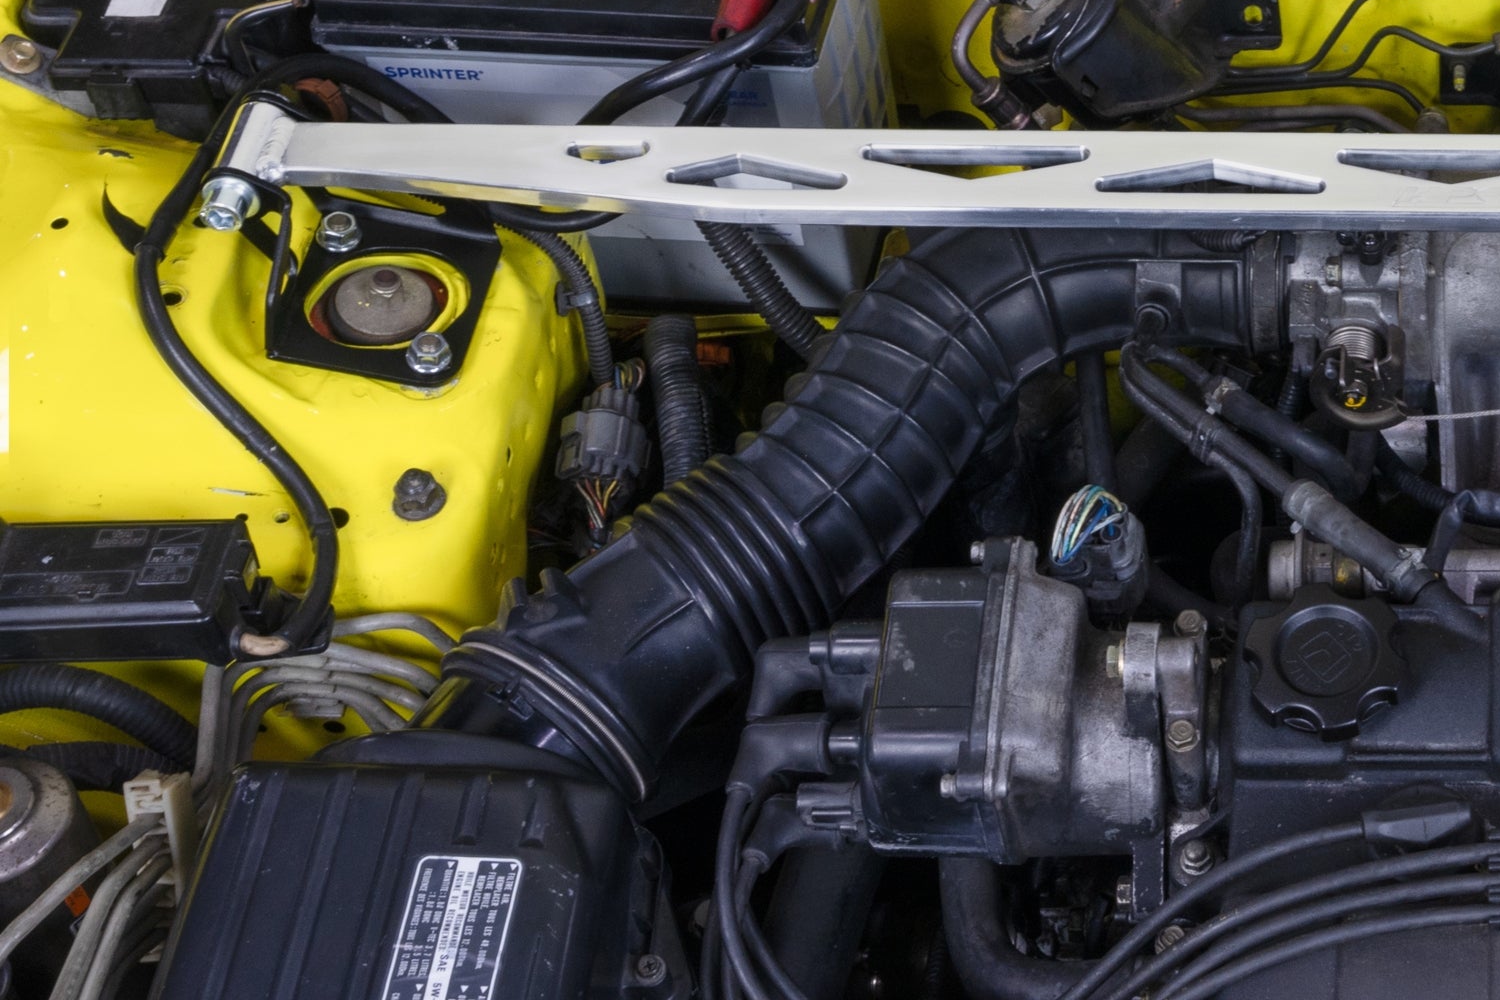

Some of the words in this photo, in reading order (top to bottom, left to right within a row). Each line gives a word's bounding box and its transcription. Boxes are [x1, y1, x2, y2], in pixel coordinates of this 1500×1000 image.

[385, 66, 480, 81] SPRINTER
[419, 868, 432, 891] FREQUENCE
[453, 871, 465, 891] ENGINE
[465, 871, 475, 886] HUILE
[484, 872, 496, 890] FILTRE
[504, 872, 516, 891] FILTRE
[416, 894, 426, 902] DES
[471, 875, 486, 906] REMPLACER
[491, 876, 504, 906] REMPLACER
[450, 896, 459, 905] OIL
[458, 890, 470, 910] MOTEUR
[422, 911, 432, 924] DOHC
[432, 911, 443, 924] DOHC
[467, 909, 478, 922] TOUS
[487, 910, 497, 923] TOUS
[464, 925, 474, 936] LES
[483, 926, 493, 936] LES
[436, 954, 449, 972] SAE
